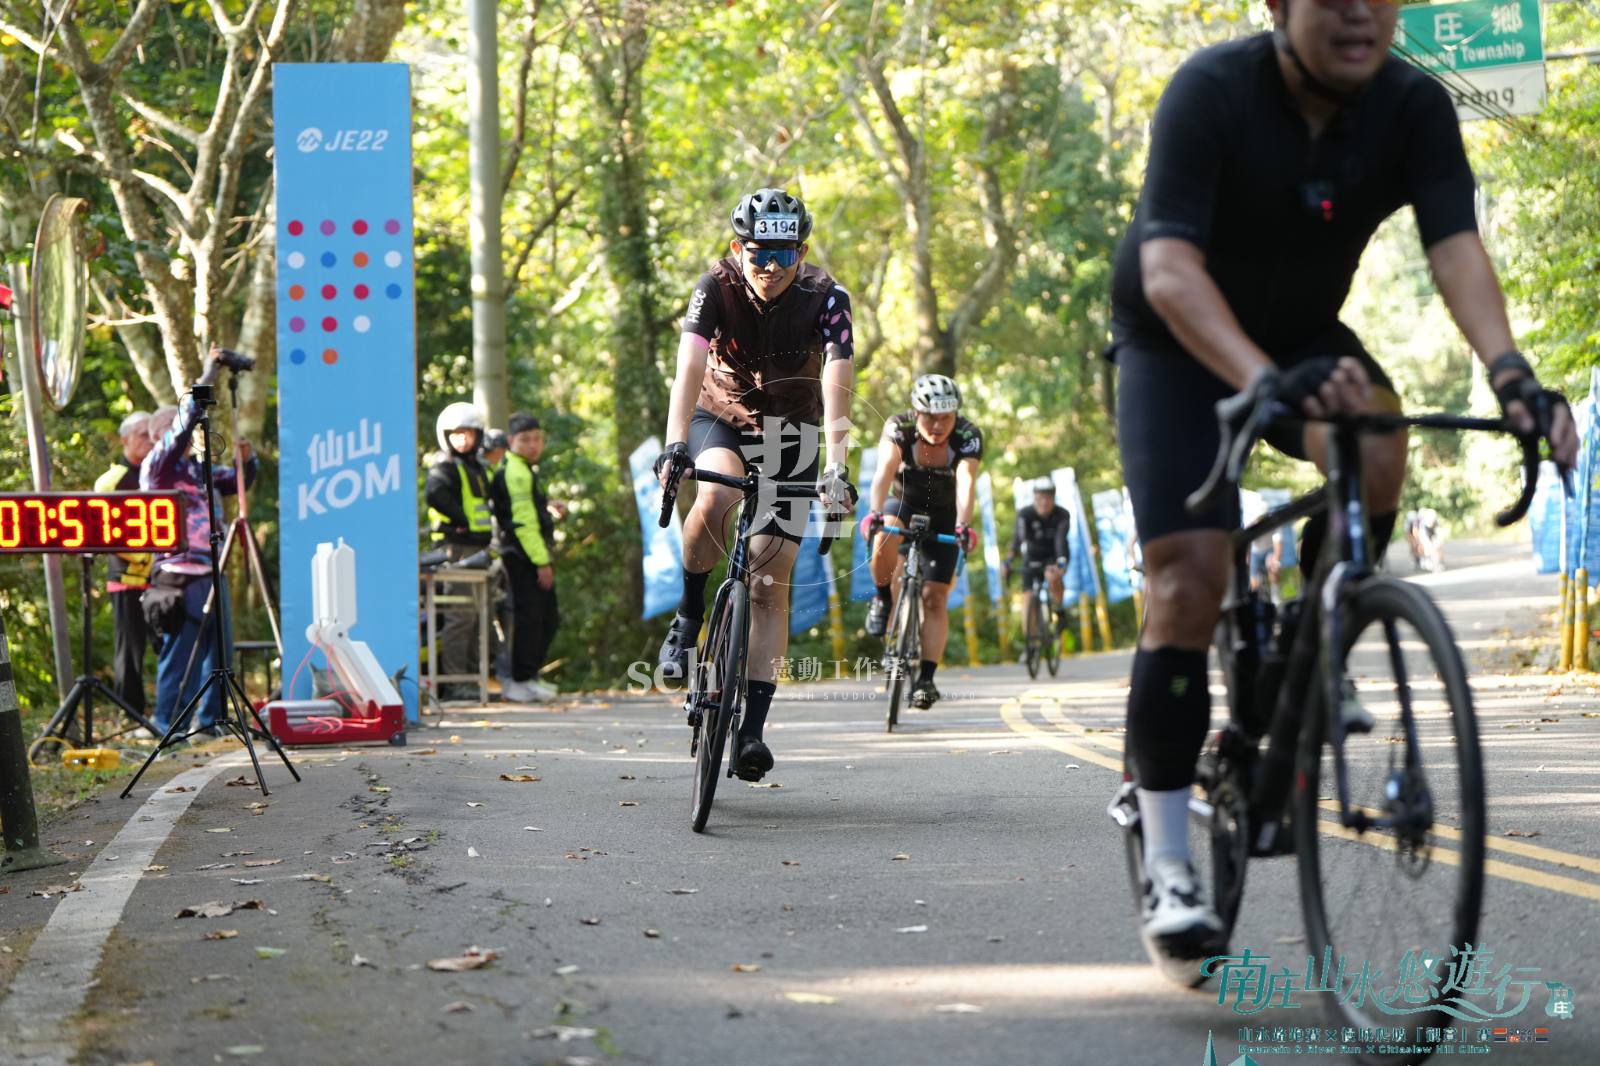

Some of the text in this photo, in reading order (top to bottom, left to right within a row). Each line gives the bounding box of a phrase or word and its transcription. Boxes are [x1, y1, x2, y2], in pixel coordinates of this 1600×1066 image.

[1460, 40, 1525, 63] Township
[324, 130, 389, 152] JE22
[759, 220, 797, 234] 3194
[307, 418, 382, 475] 仙山
[297, 454, 401, 520] KOM
[0, 498, 177, 548] 07:57:38
